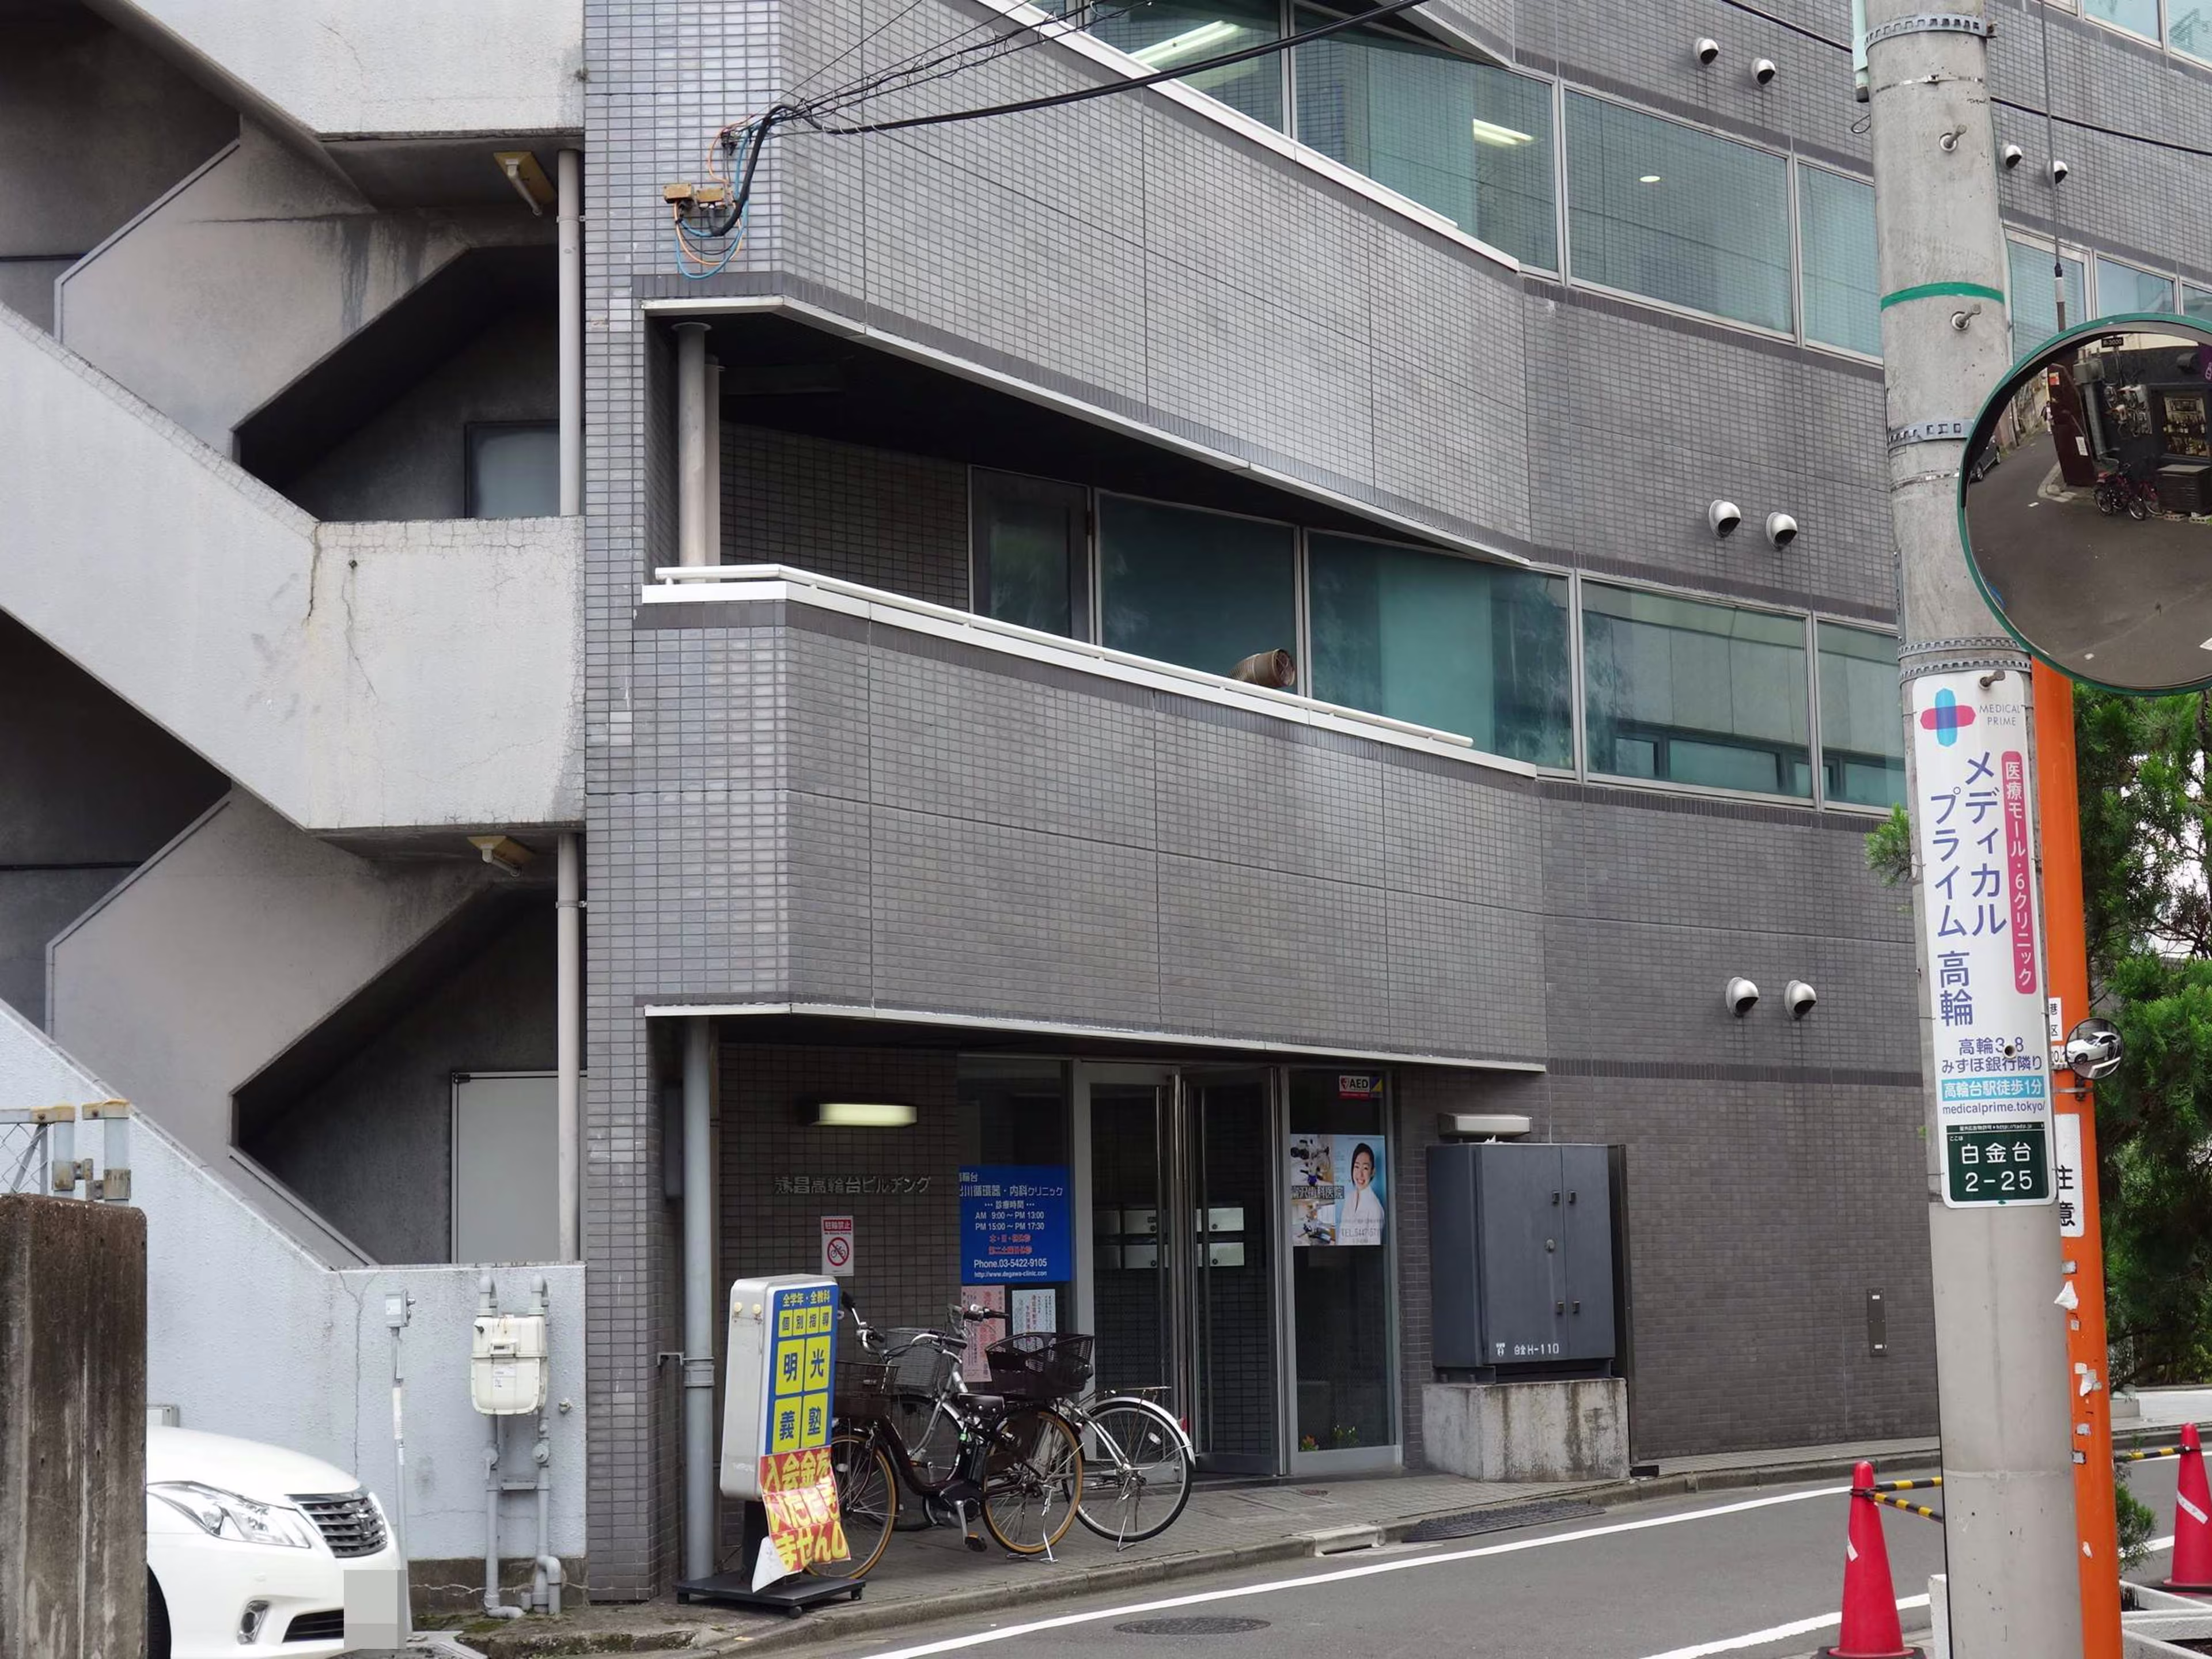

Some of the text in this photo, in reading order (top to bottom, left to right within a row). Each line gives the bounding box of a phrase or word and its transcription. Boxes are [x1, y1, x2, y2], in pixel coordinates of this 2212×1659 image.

[1979, 704, 2021, 714] MEDICAL
[1987, 717, 2016, 726] PRIME
[1965, 751, 2008, 937] メディカル
[2005, 762, 2032, 986] 医療モール・6クリニック
[1959, 1037, 2024, 1055] 高輪38
[1942, 1055, 2043, 1074] みずほ銀行隣り
[1349, 1078, 1368, 1088] AED
[1944, 1079, 2043, 1098] 高輪台駅徒歩1分
[1942, 1101, 2045, 1116] medicalprime.tokyo/
[1961, 1141, 2032, 1164] 白金台
[1965, 1170, 2033, 1192] 2-25
[975, 1211, 987, 1219] AM
[991, 1211, 1005, 1219] 9:00
[1014, 1211, 1025, 1219] PM
[1028, 1211, 1044, 1219] 13:00
[988, 1222, 1005, 1230] 15:00
[1028, 1222, 1044, 1230] 17:30
[974, 1258, 1047, 1268] Phone.03-5422-9105
[782, 1290, 830, 1307] 全学年・全教科
[781, 1312, 830, 1331] 個別指導
[783, 1348, 825, 1382] 明光
[779, 1406, 822, 1440] 義塾
